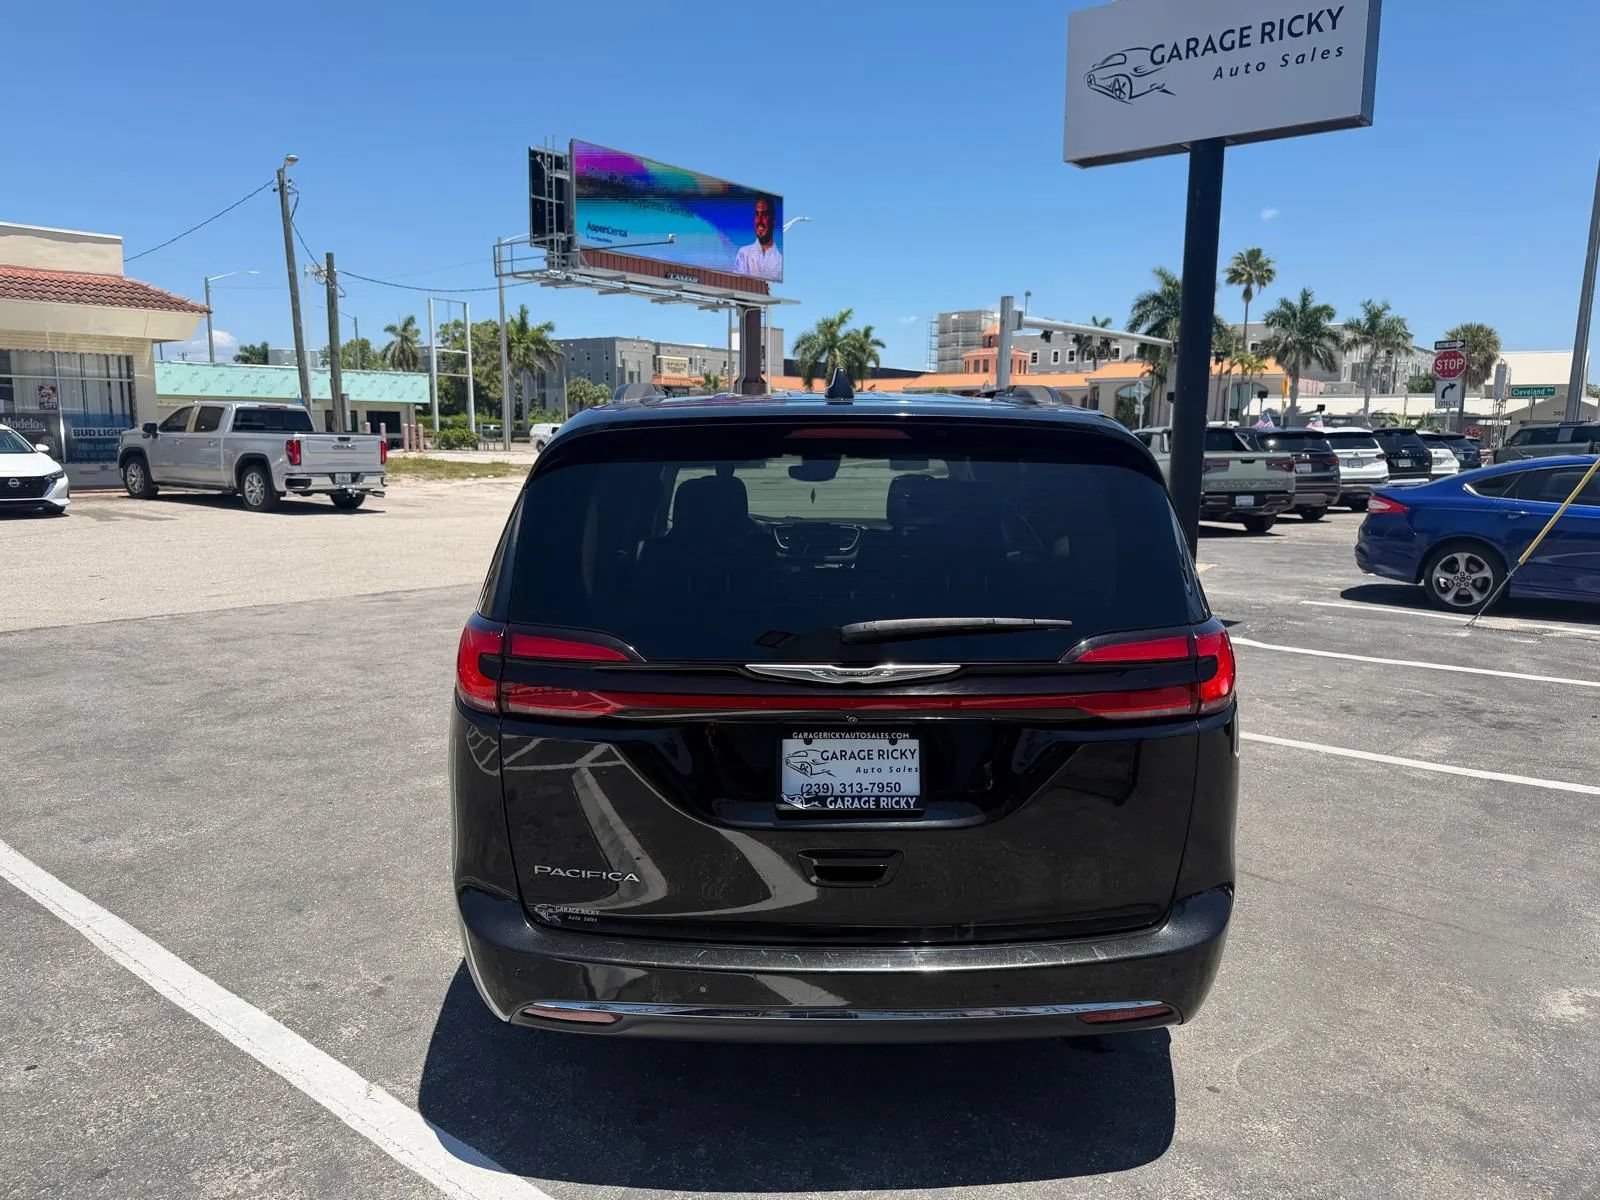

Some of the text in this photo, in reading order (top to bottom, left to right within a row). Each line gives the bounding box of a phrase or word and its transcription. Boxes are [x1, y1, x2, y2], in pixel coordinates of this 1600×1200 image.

[1150, 5, 1345, 66] GARAGE RICKY
[1212, 46, 1344, 81] Auto Sales
[1435, 358, 1464, 371] STOP
[1512, 388, 1546, 396] Cleveland
[73, 428, 96, 437] BUD
[820, 748, 917, 761] GARAGE RICKY
[855, 765, 919, 774] Auto Sales
[800, 782, 902, 795] (239) 313-7950
[826, 797, 917, 809] GARAGE RICKY
[534, 864, 641, 882] PACIFICA
[555, 905, 600, 916] GARAGE RICKY
